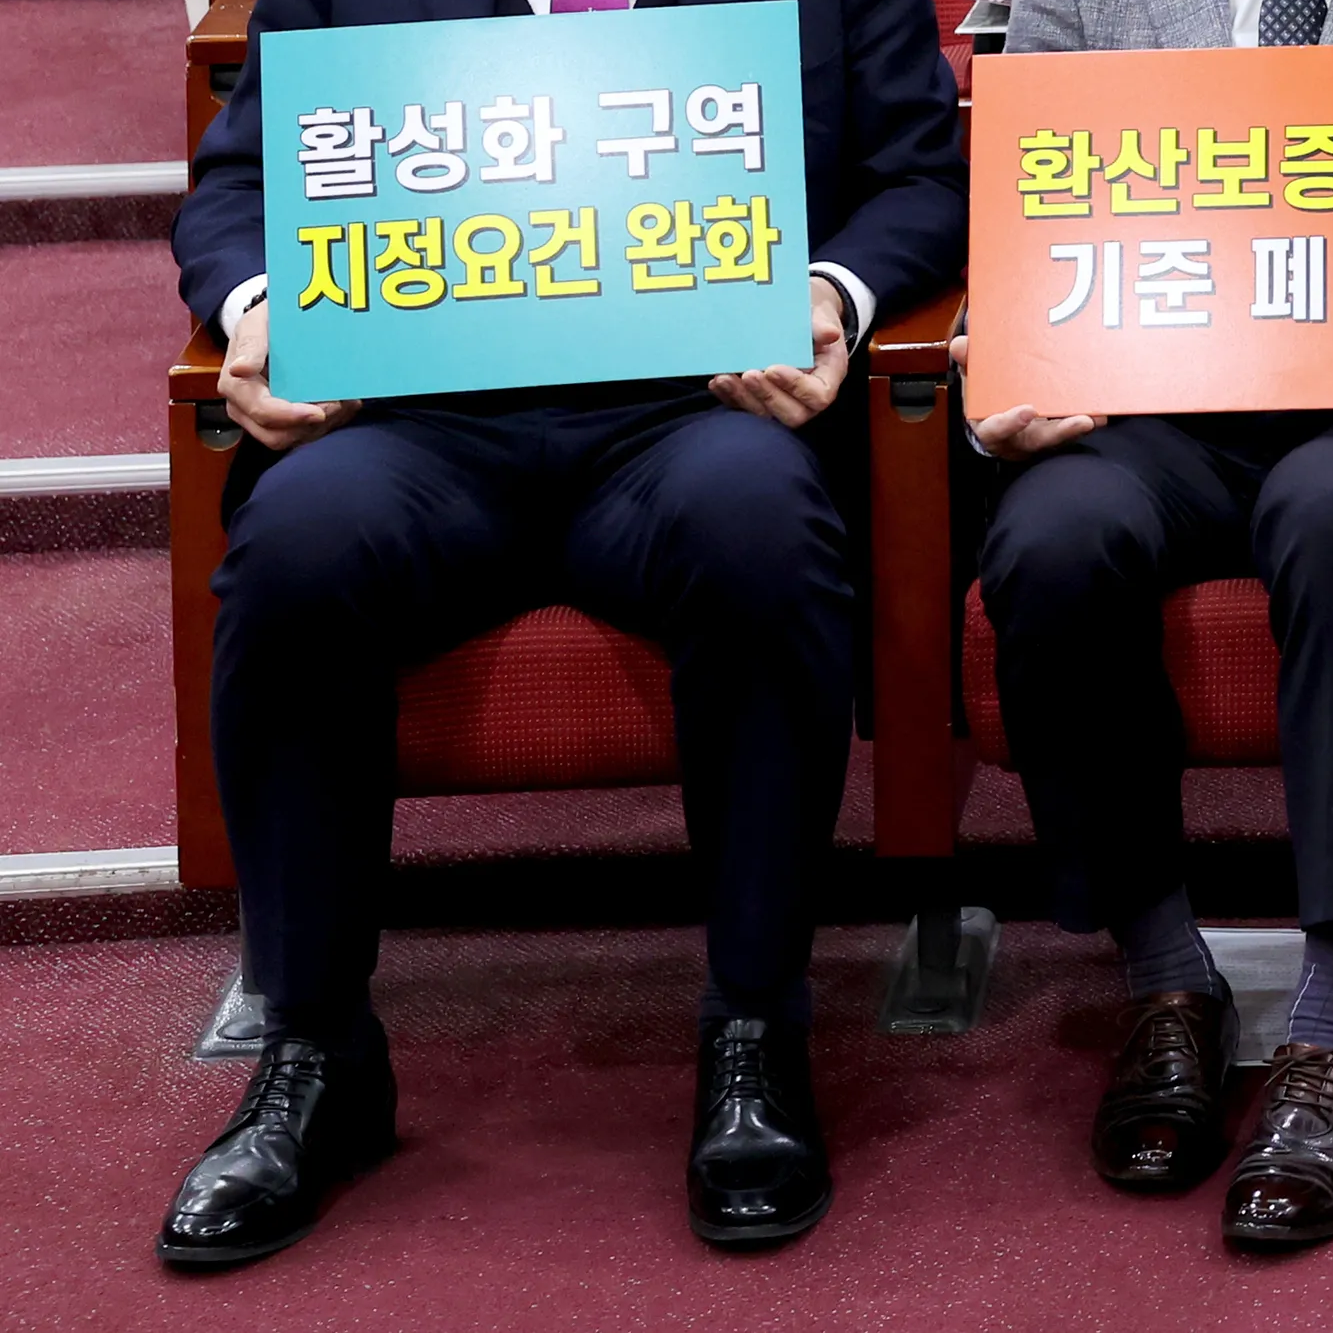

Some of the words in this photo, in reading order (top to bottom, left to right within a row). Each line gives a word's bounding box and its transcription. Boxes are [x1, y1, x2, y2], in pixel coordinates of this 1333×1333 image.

[298, 95, 565, 200] 활성화
[597, 82, 765, 180] 구역
[298, 206, 602, 312] 지정요건
[626, 195, 781, 294] 완화
[1048, 238, 1215, 328] 기준
